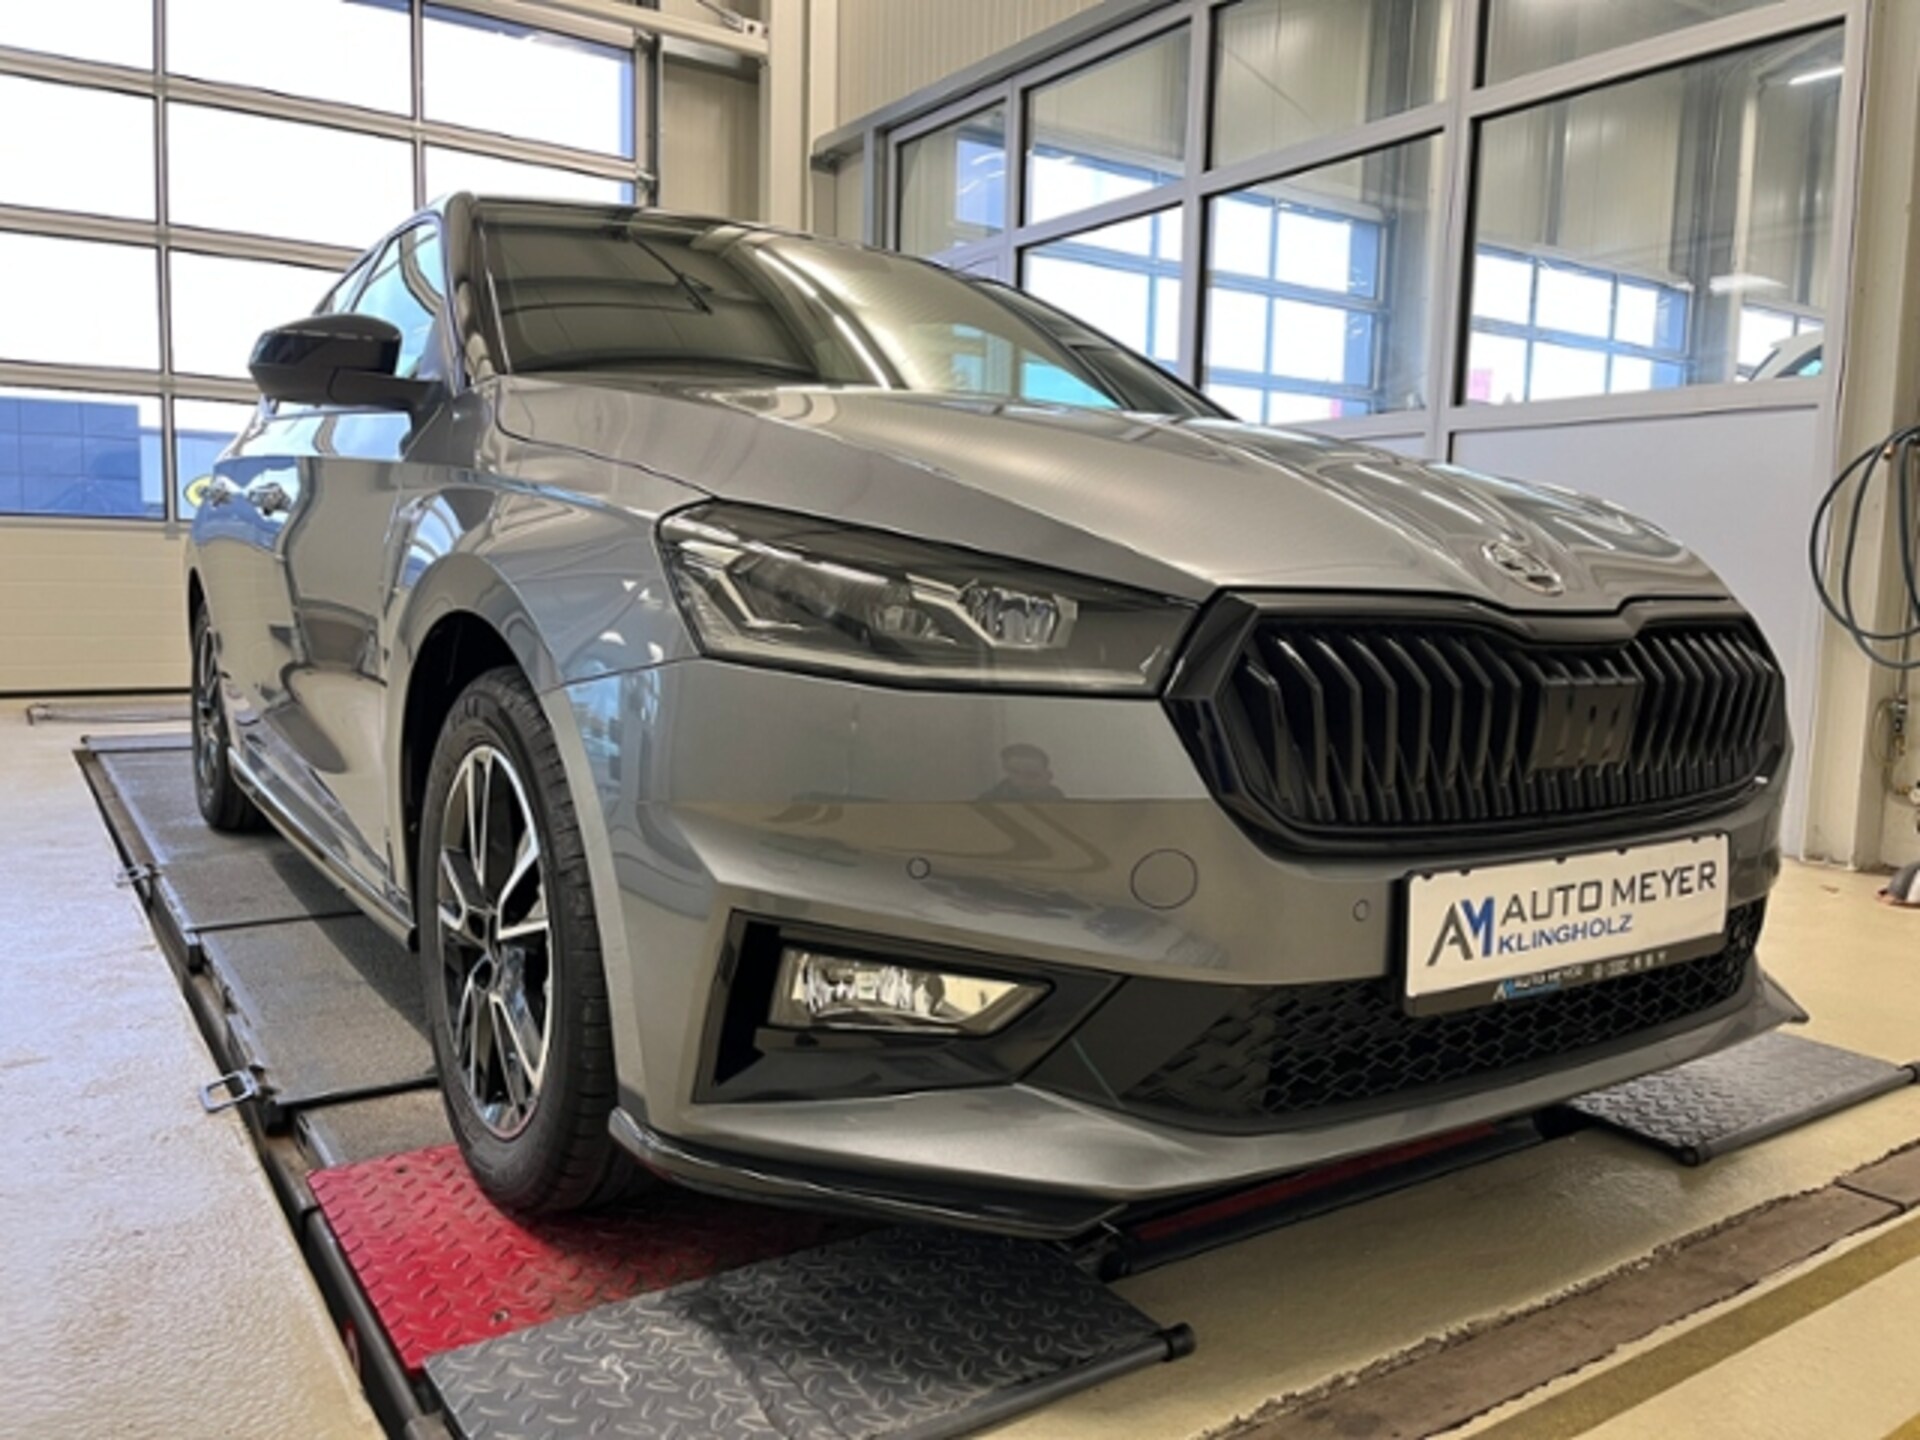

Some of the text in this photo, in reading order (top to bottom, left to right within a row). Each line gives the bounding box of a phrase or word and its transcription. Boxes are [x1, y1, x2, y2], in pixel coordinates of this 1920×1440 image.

[1501, 860, 1718, 926] AUTO MEYER
[1499, 913, 1634, 954] KLINGHOLZ
